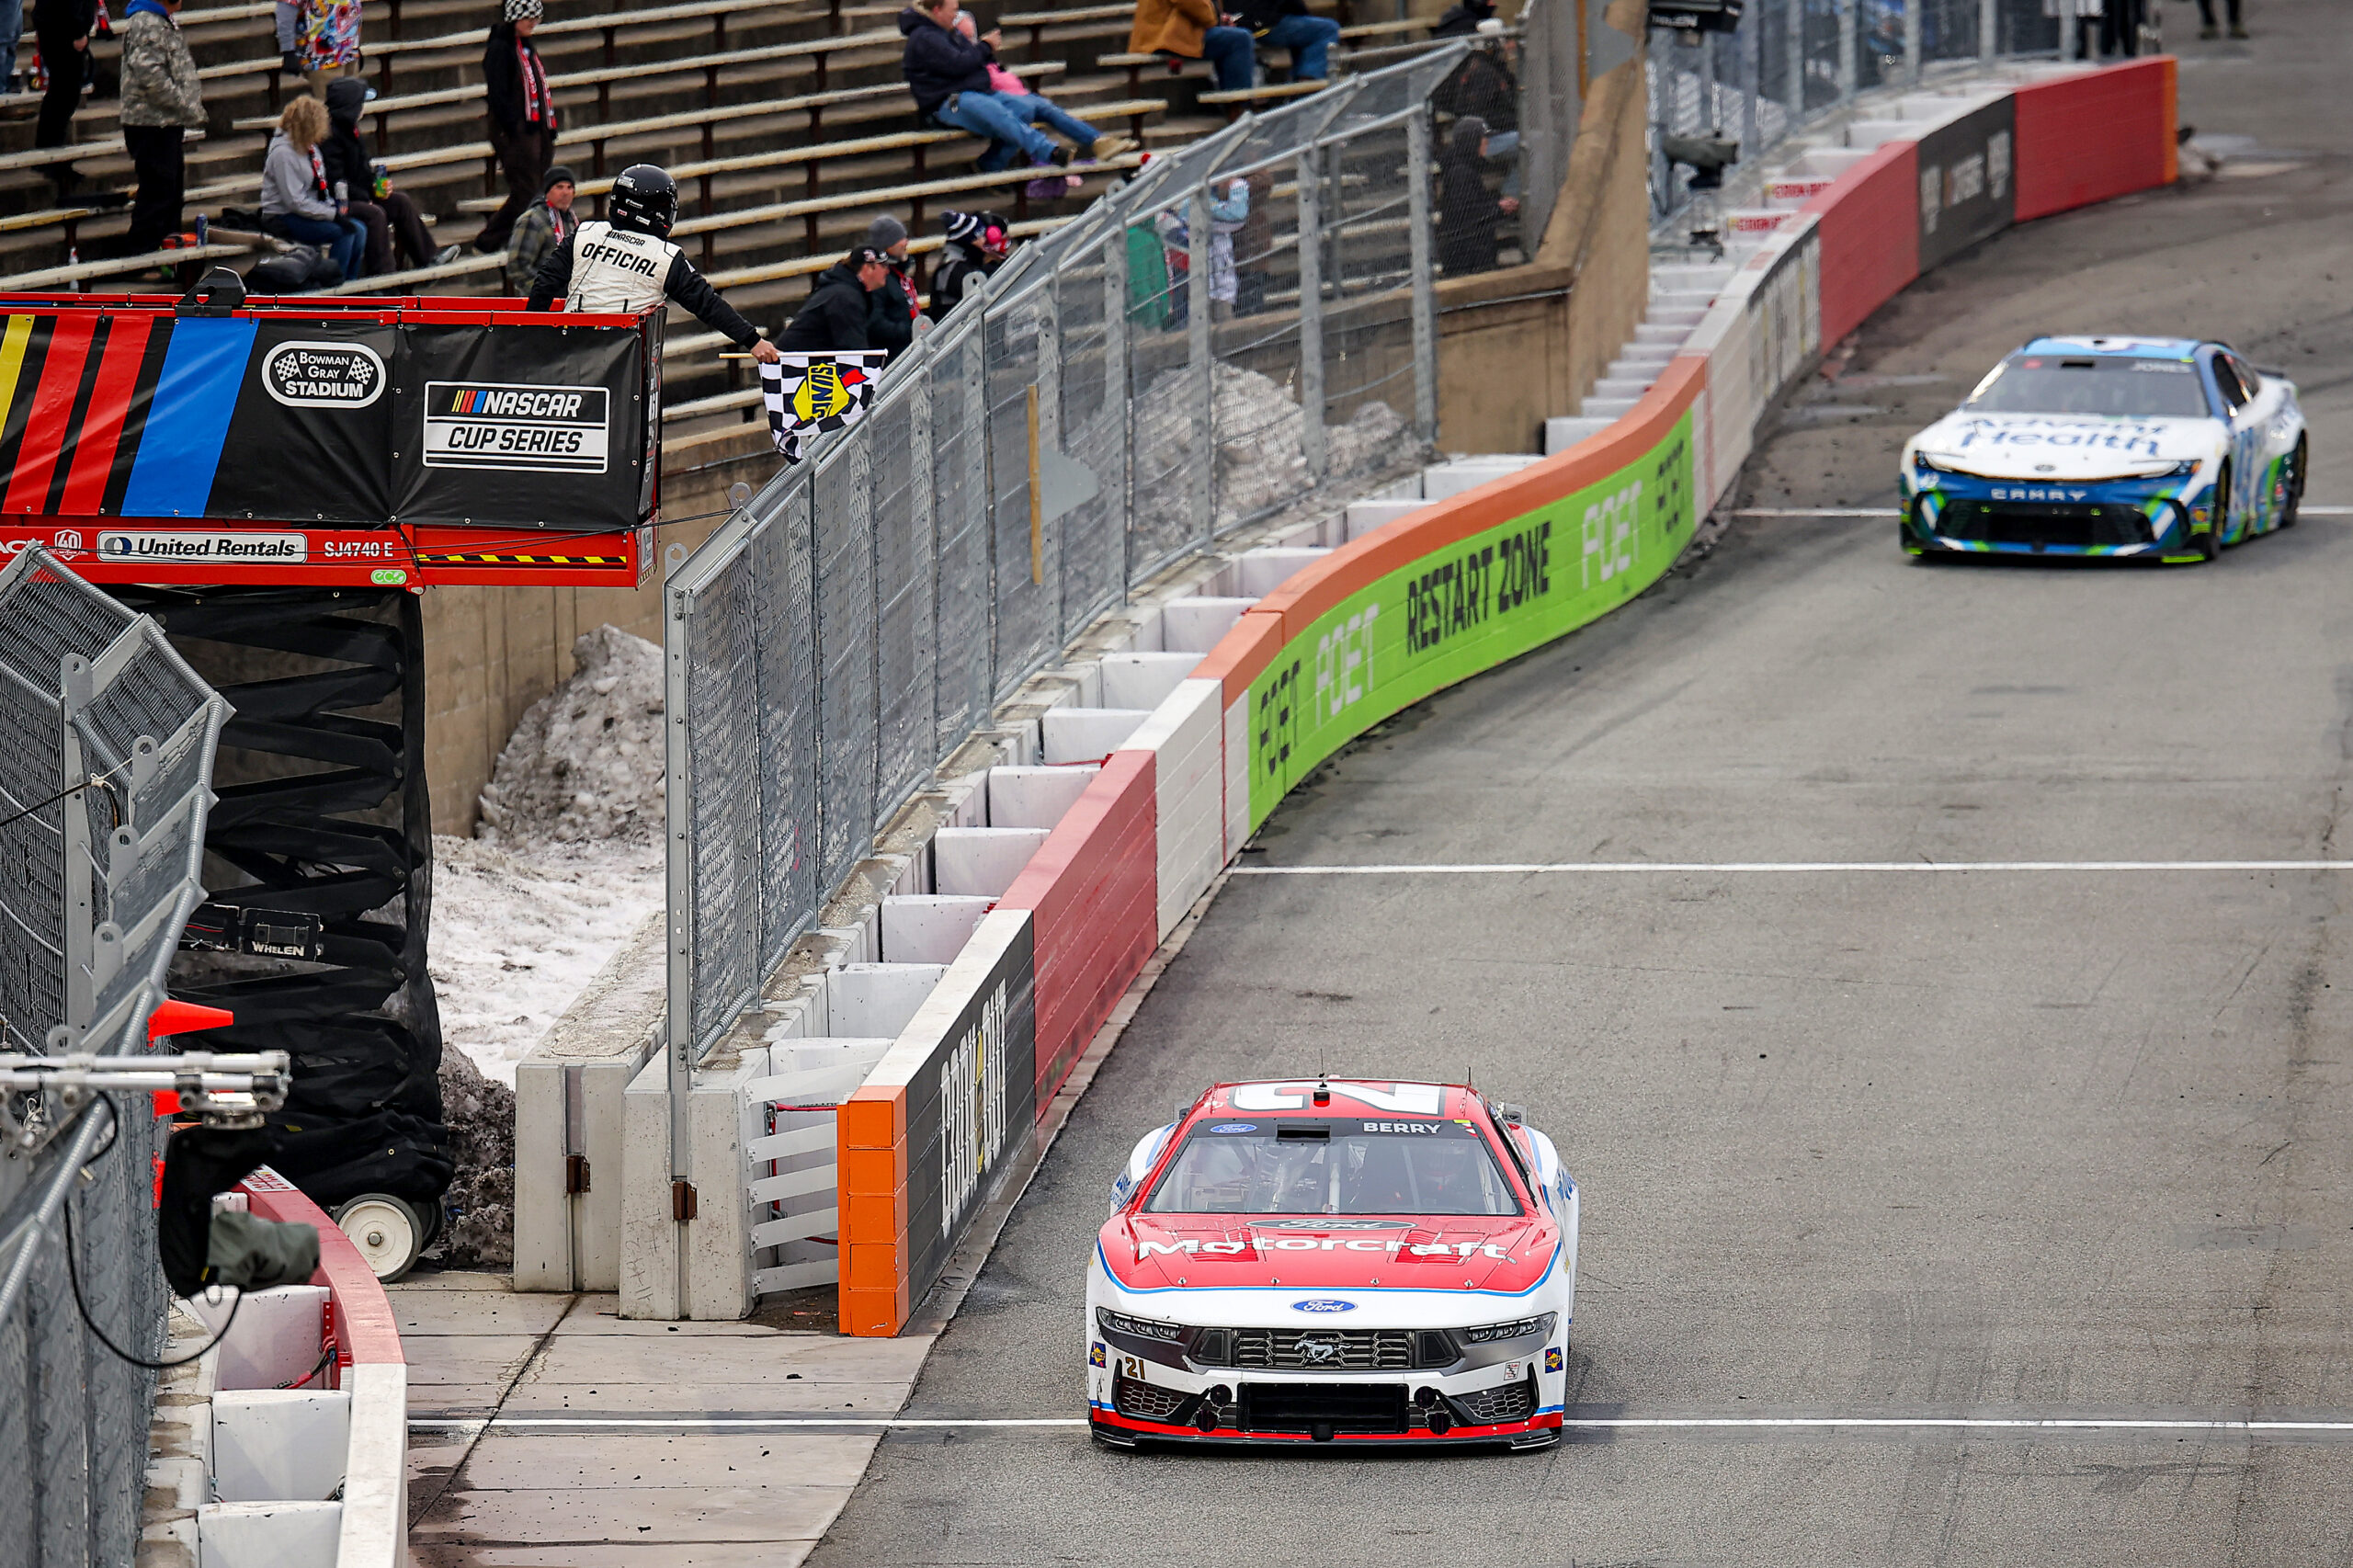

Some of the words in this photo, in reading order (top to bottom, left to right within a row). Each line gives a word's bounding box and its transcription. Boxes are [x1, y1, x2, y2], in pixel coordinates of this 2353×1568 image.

[614, 230, 646, 247] NASCAR
[581, 243, 659, 278] OFFICIAL
[299, 351, 349, 366] BOWMAN
[307, 365, 340, 379] GRAY
[285, 381, 364, 398] STADIUM
[483, 391, 583, 417] NASCAR
[448, 426, 497, 450] CUP
[498, 428, 584, 453] SERIES
[139, 538, 211, 557] United
[215, 539, 296, 557] Rentals
[324, 541, 381, 557] SJ4740
[383, 542, 393, 557] E
[1407, 546, 1494, 657] RESTART
[1497, 520, 1552, 614] ZONE
[252, 941, 305, 957] WHELEN
[982, 977, 1007, 1175] OUT
[1363, 1122, 1442, 1134] BERRY
[1137, 1236, 1509, 1261] Motorcraft
[1302, 1300, 1346, 1312] Ford
[1125, 1356, 1146, 1381] 21
